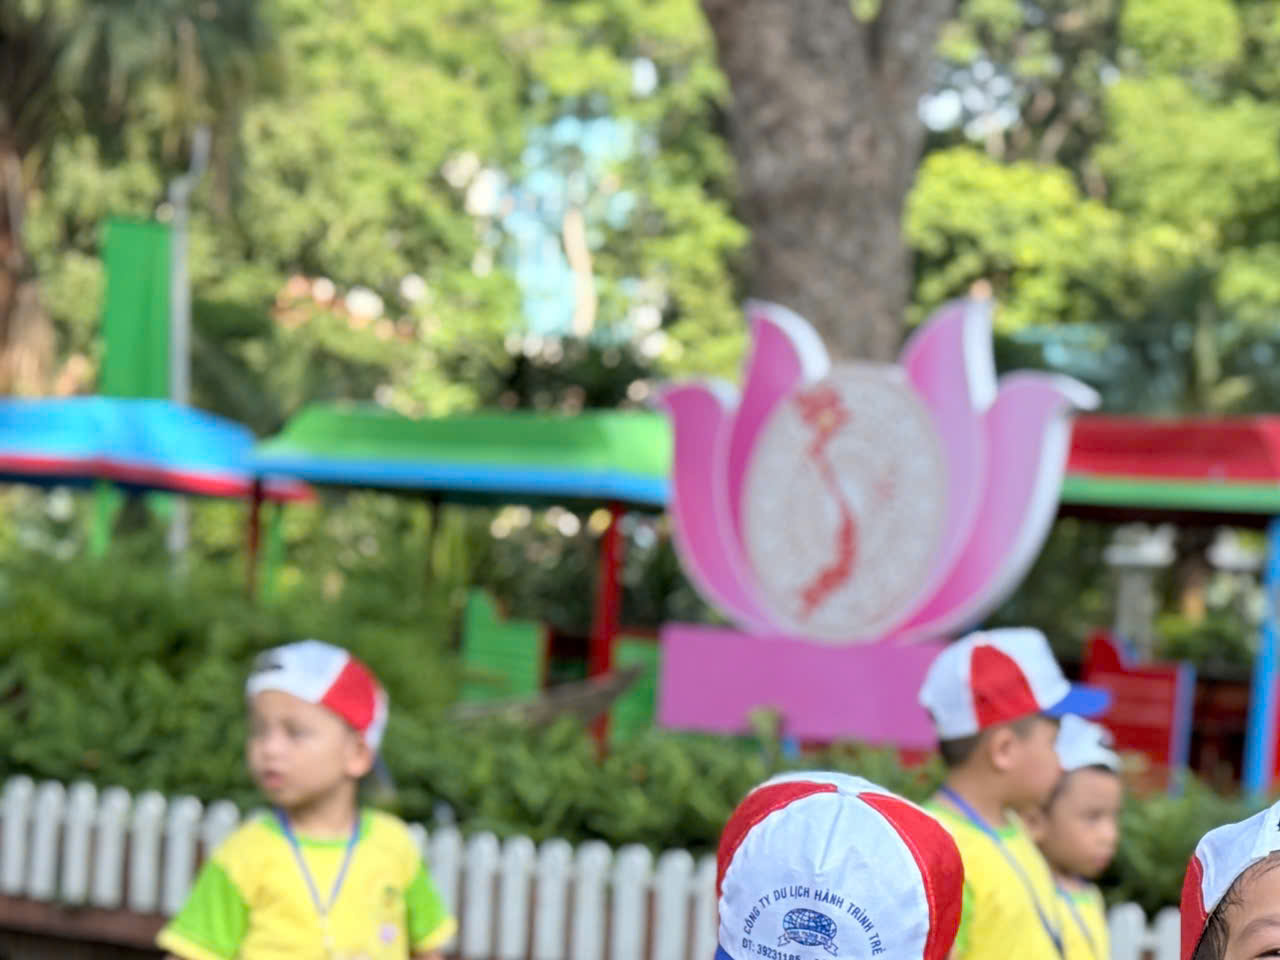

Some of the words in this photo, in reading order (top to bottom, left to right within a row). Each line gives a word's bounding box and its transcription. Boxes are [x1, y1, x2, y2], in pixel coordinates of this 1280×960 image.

[743, 906, 761, 935] CÔNG
[758, 894, 771, 909] TY
[773, 887, 787, 901] DU
[789, 885, 810, 900] LỊCH
[846, 902, 875, 933] TRÌNH
